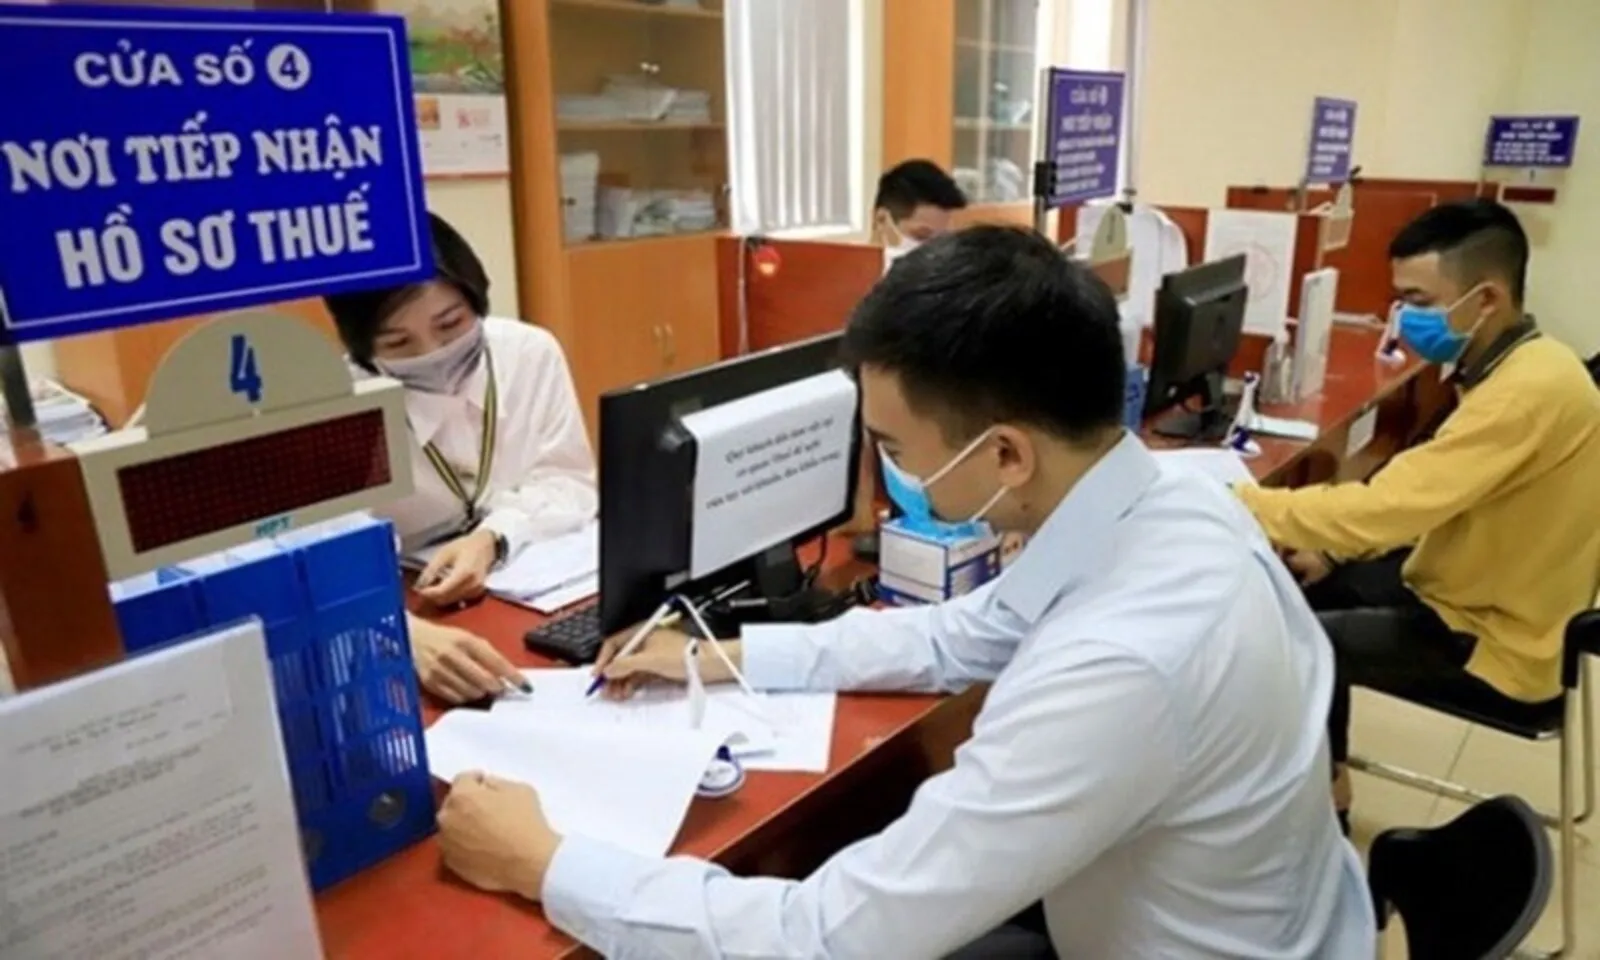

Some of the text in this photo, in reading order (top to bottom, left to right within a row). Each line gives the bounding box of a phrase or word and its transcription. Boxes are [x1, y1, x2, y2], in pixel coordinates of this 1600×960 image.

[75, 38, 182, 86] CỬA
[194, 38, 255, 85] SỐ
[1, 110, 383, 193] NƠI TIẾP NHẬN
[55, 182, 375, 289] HỒ SƠ THUẾ
[230, 334, 262, 403] 4
